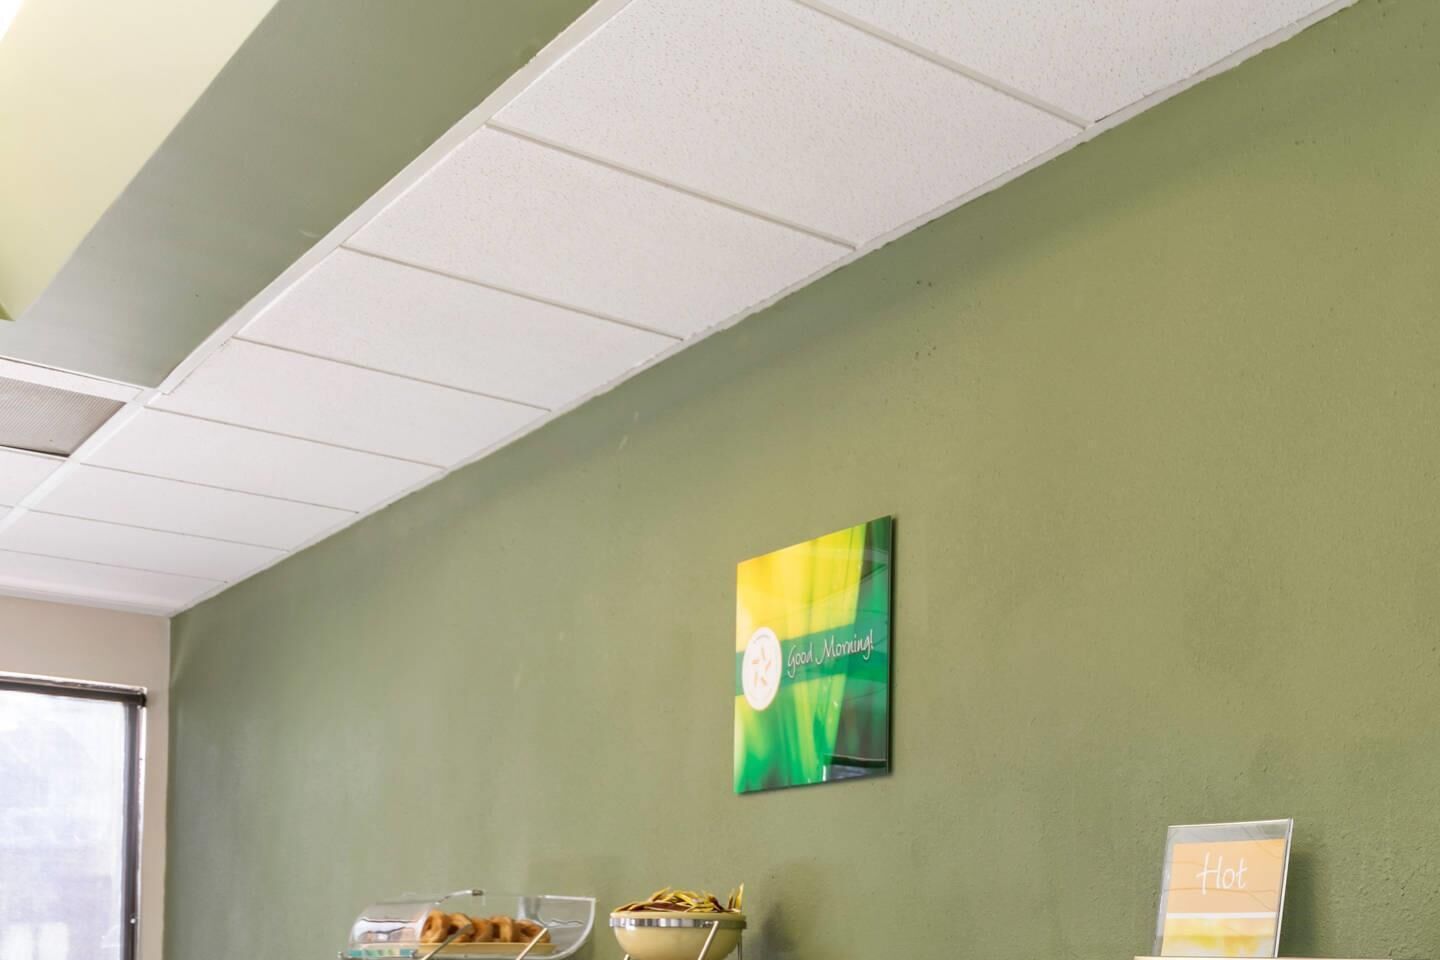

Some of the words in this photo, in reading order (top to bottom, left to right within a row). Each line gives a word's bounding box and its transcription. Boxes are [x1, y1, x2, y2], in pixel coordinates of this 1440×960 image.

[787, 645, 813, 678] Good
[816, 629, 874, 664] Morning!
[1196, 852, 1248, 895] Hot
